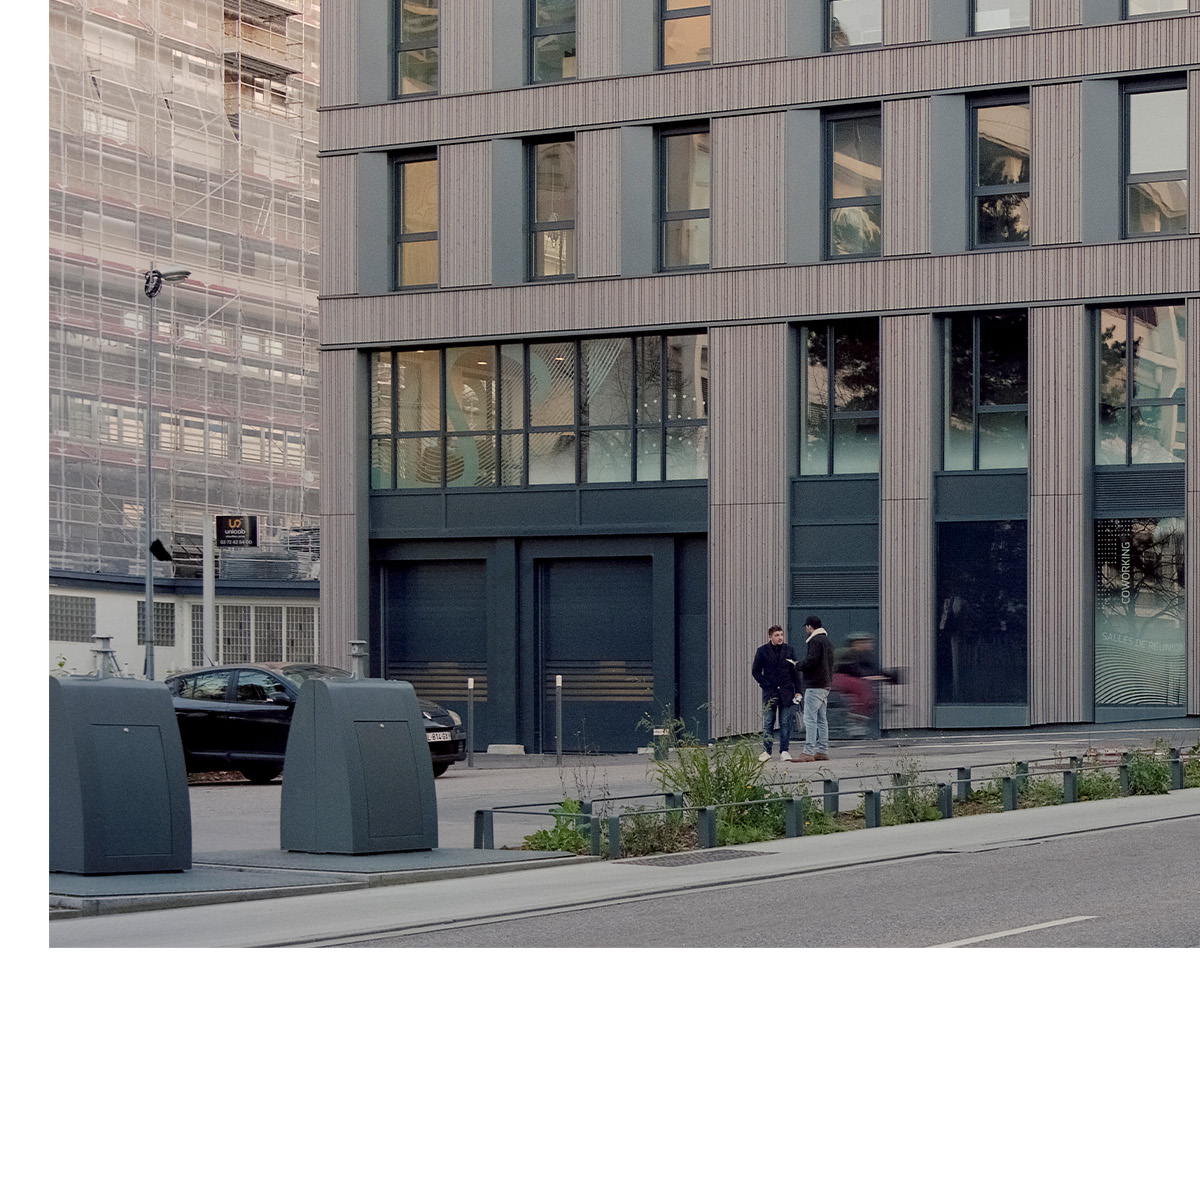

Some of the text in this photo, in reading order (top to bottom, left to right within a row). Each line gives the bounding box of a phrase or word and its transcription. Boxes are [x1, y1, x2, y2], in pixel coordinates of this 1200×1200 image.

[1121, 541, 1131, 604] COWORKING
[1102, 632, 1134, 645] SALLES
[1135, 638, 1147, 648] DE
